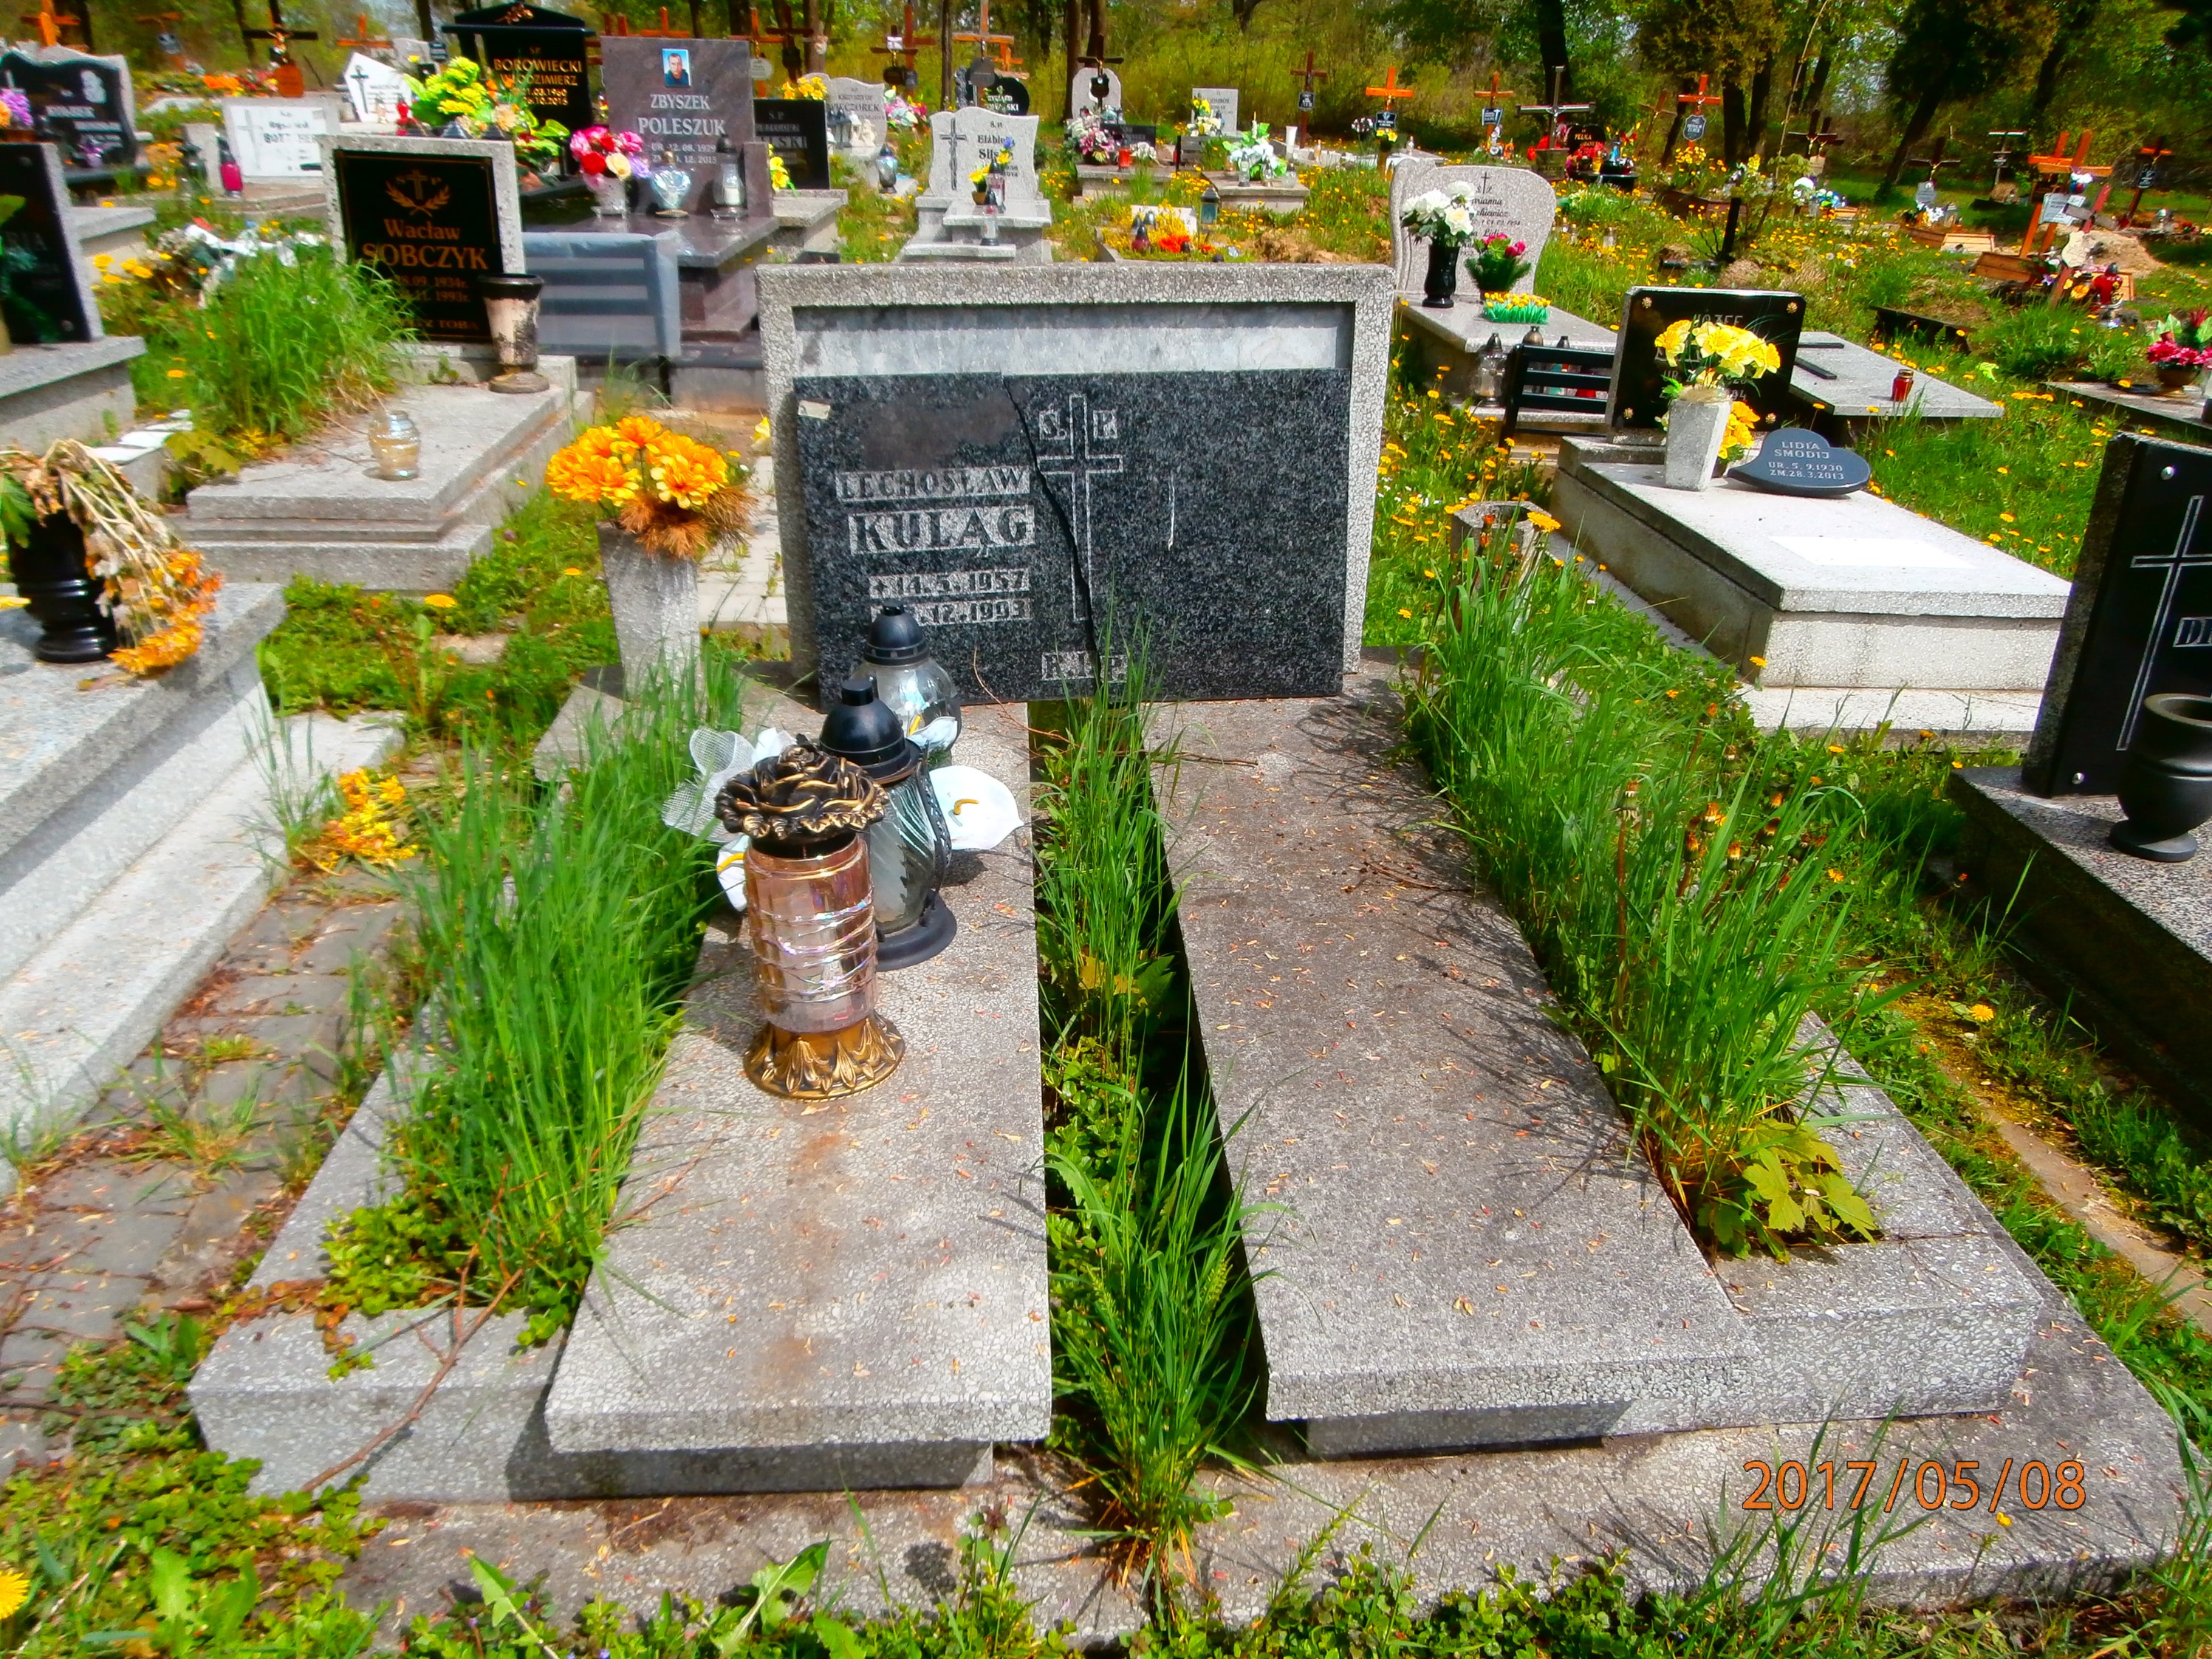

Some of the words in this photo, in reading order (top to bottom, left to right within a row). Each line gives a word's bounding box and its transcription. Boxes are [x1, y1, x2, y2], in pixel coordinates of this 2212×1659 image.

[493, 58, 582, 72] BOROWIECKI
[650, 94, 710, 110] ZBYSZEK
[637, 117, 725, 136] POLESZUK
[383, 219, 460, 240] Wacław
[361, 242, 489, 270] SOBCZYK
